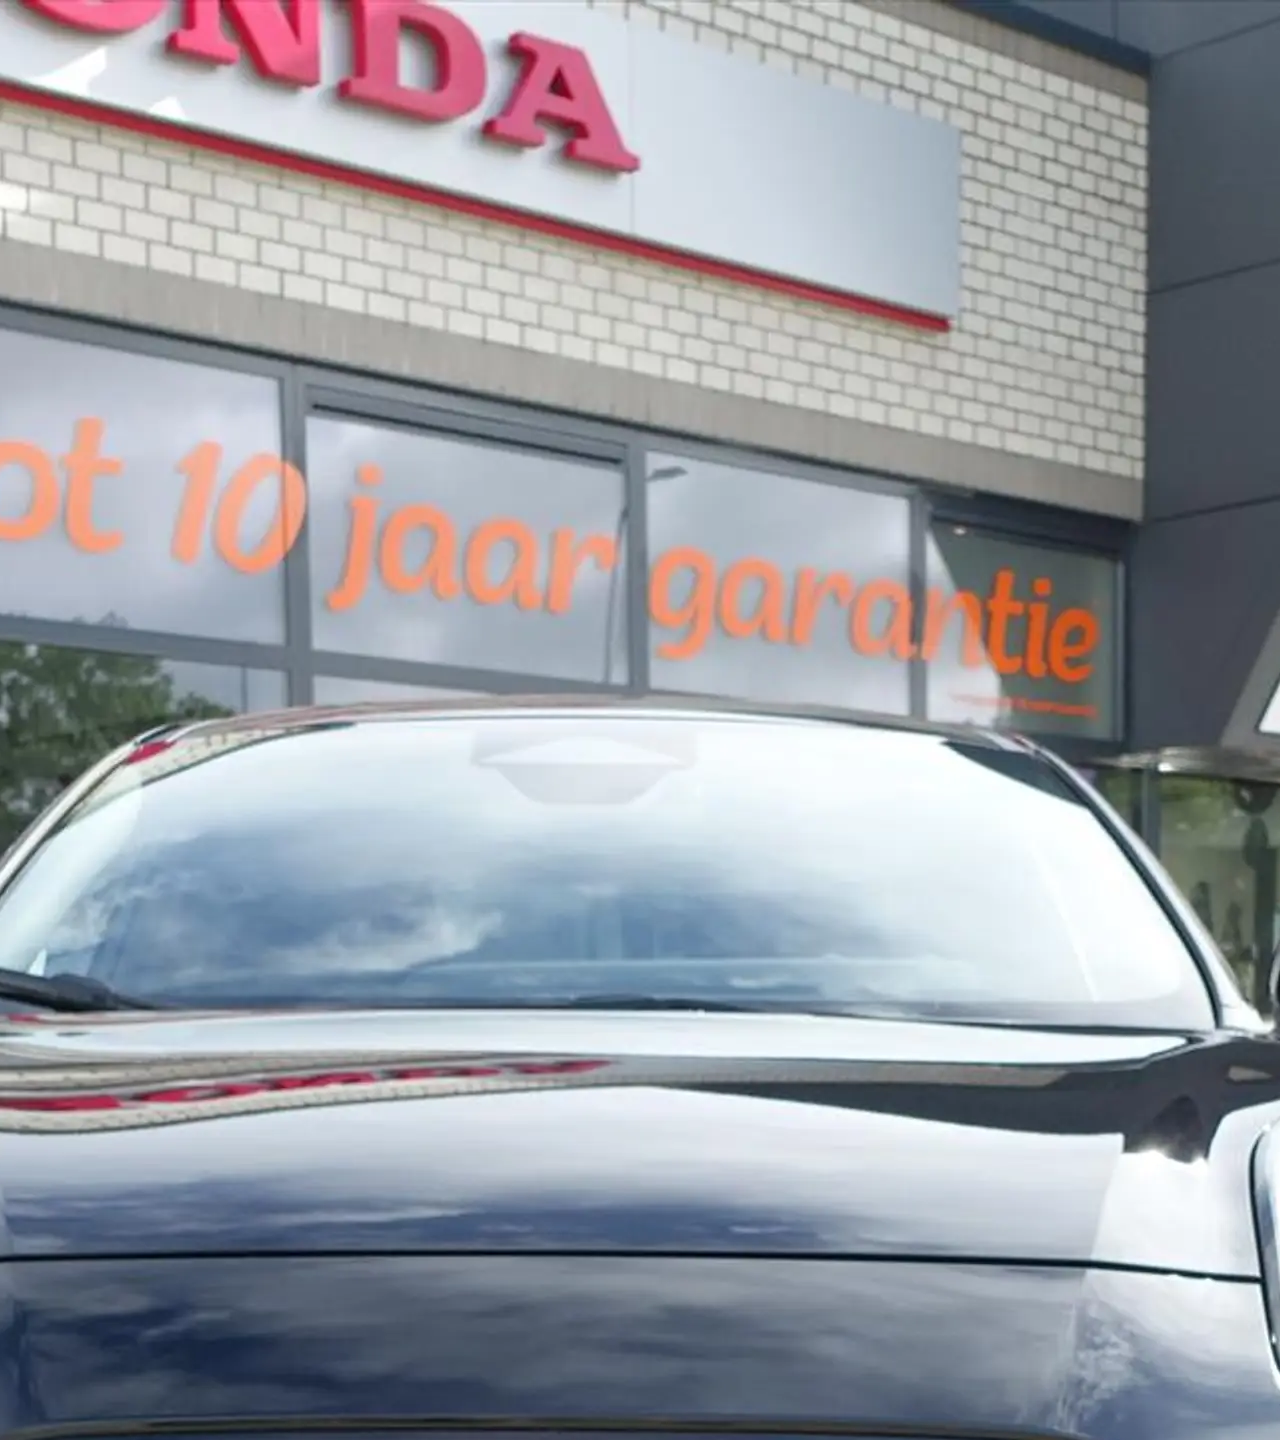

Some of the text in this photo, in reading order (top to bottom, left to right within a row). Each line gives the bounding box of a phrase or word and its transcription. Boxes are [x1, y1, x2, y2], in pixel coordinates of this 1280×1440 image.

[21, 0, 641, 172] NDA
[171, 441, 306, 574] 10
[325, 465, 616, 612] jaar
[649, 547, 1099, 683] garantie
